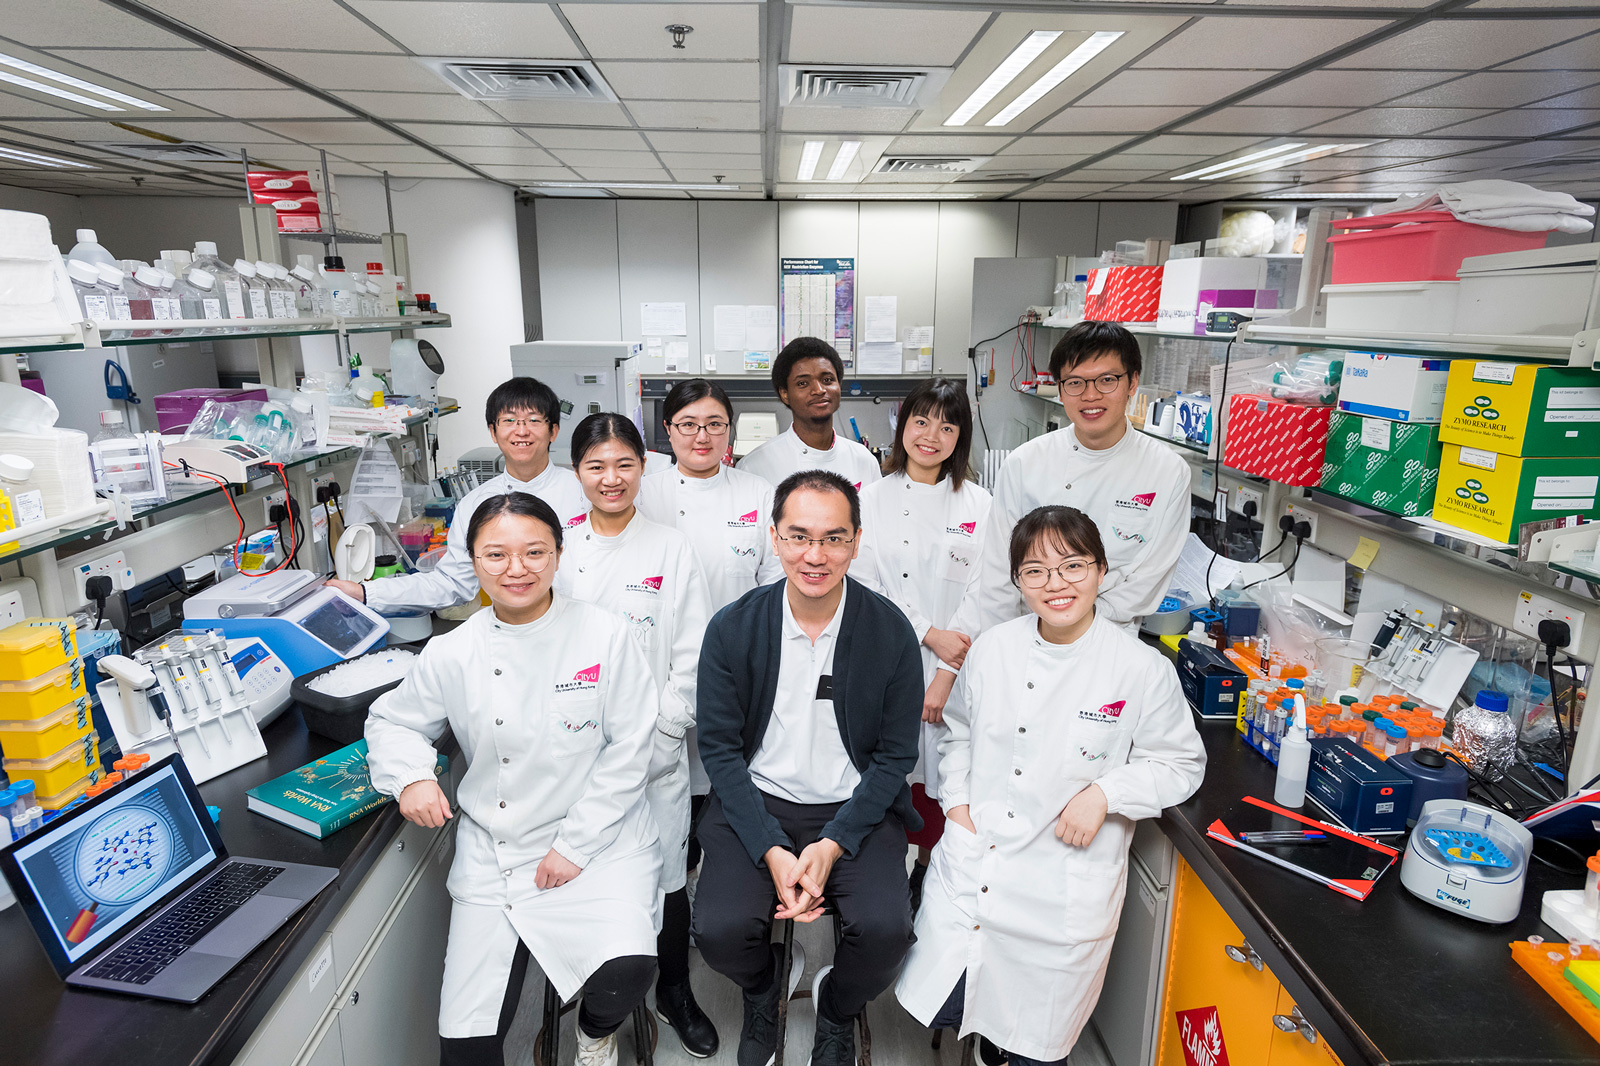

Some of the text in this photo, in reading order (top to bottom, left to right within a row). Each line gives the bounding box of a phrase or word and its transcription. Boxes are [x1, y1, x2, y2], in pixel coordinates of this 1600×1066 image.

[1454, 417, 1507, 432] ZYMO RESEARCH
[1446, 497, 1495, 516] ZYMO RESEARCH
[576, 673, 596, 681] CityU
[1102, 706, 1120, 715] CityU
[283, 790, 332, 812] RNA Worlds
[349, 796, 386, 820] RNA Worlds
